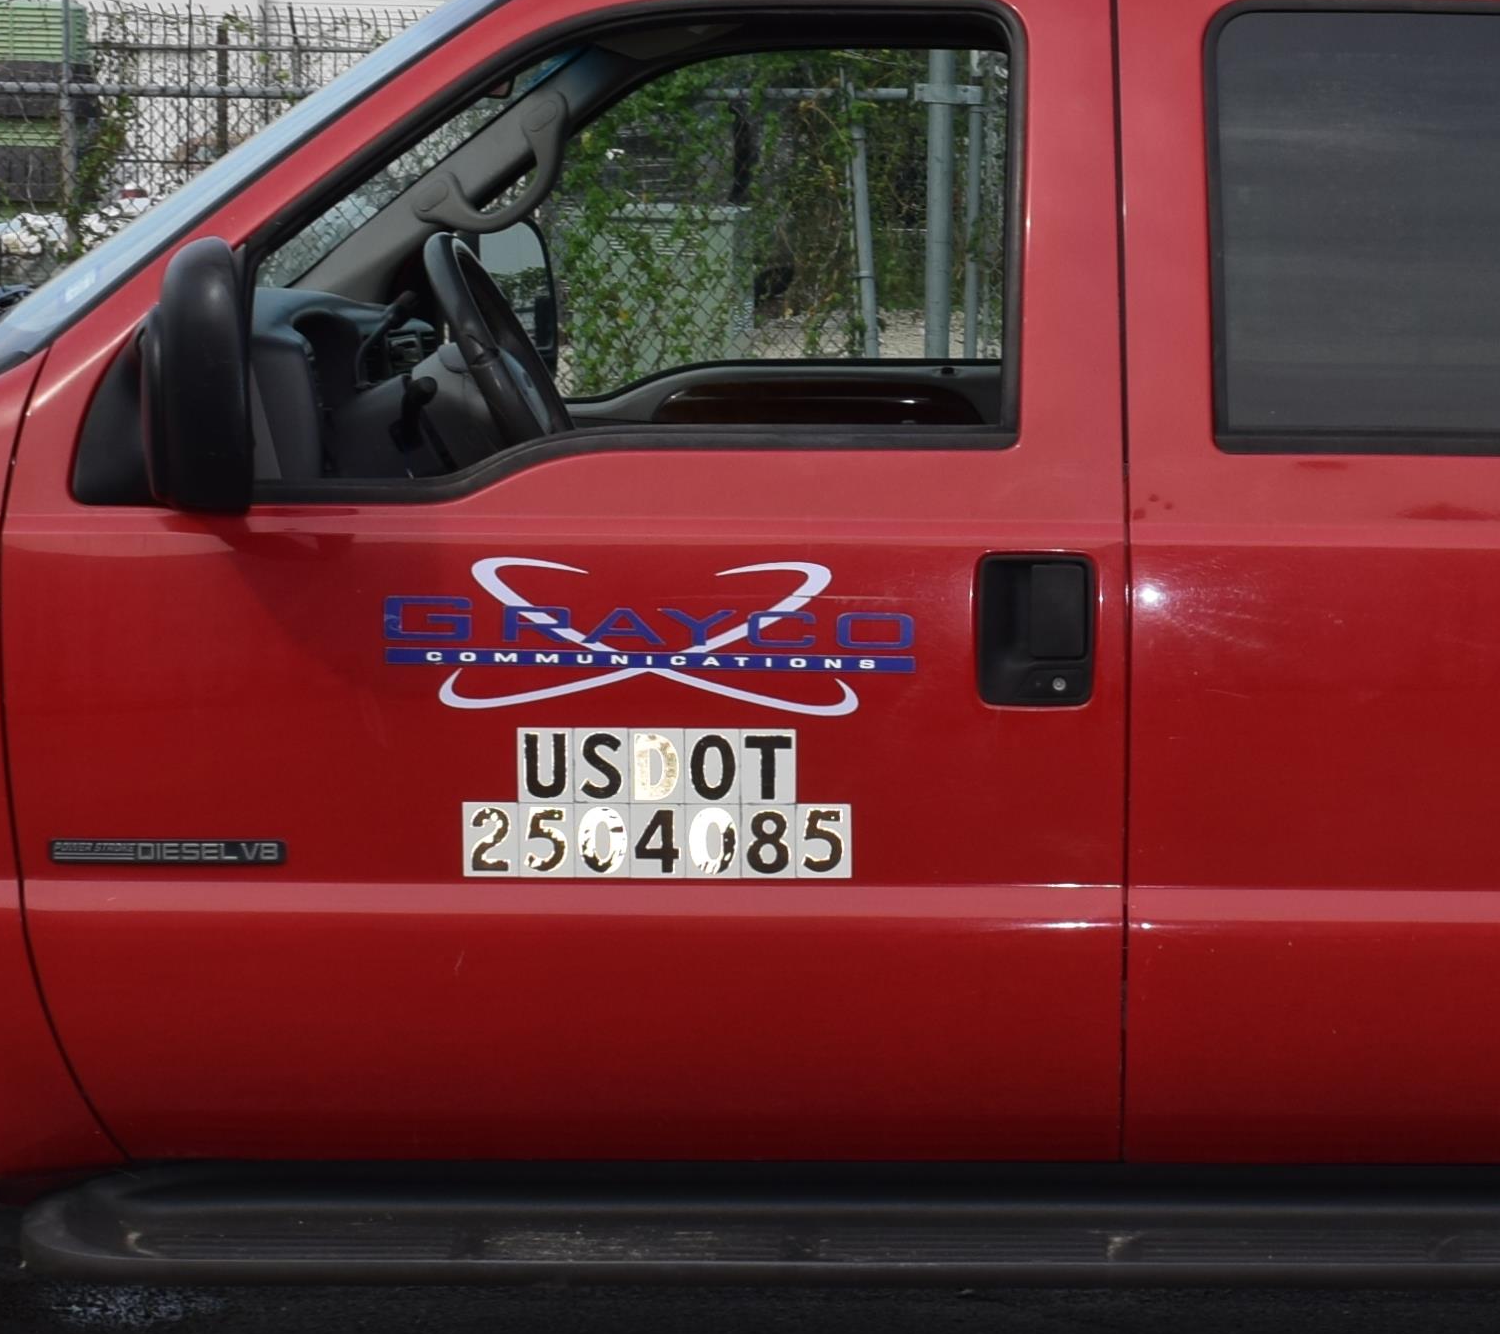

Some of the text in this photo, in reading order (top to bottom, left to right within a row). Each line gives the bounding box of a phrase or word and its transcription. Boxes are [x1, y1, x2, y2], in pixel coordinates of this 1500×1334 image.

[383, 595, 915, 649] GRAYCO
[425, 650, 877, 670] COMMUNICATIONS
[138, 843, 238, 860] DIESEL
[240, 843, 278, 860] V8
[470, 806, 844, 876] 2504085
